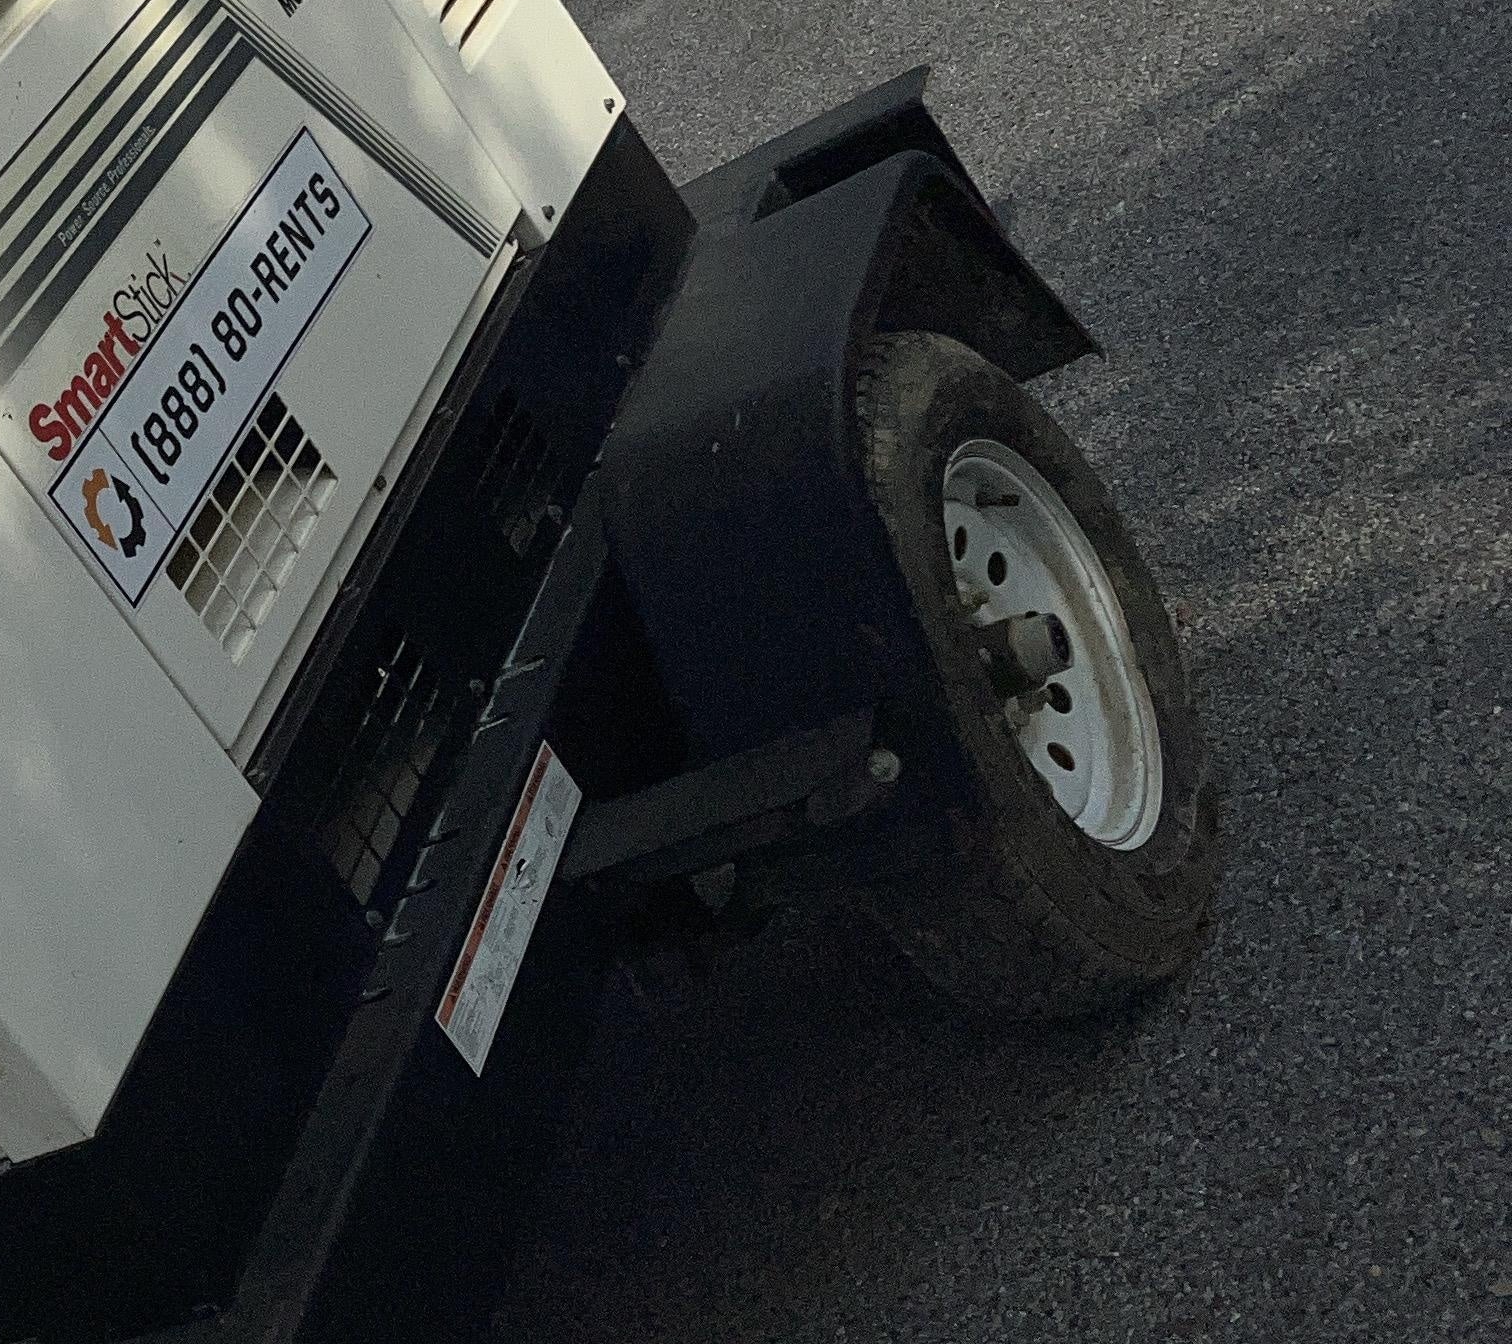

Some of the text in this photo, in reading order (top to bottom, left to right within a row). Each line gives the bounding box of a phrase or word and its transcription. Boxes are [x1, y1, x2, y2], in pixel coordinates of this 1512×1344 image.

[58, 215, 85, 248] Power
[81, 182, 112, 216] Source
[29, 252, 179, 461] SmartStick
[130, 172, 341, 486] (888) 80-RENTS
